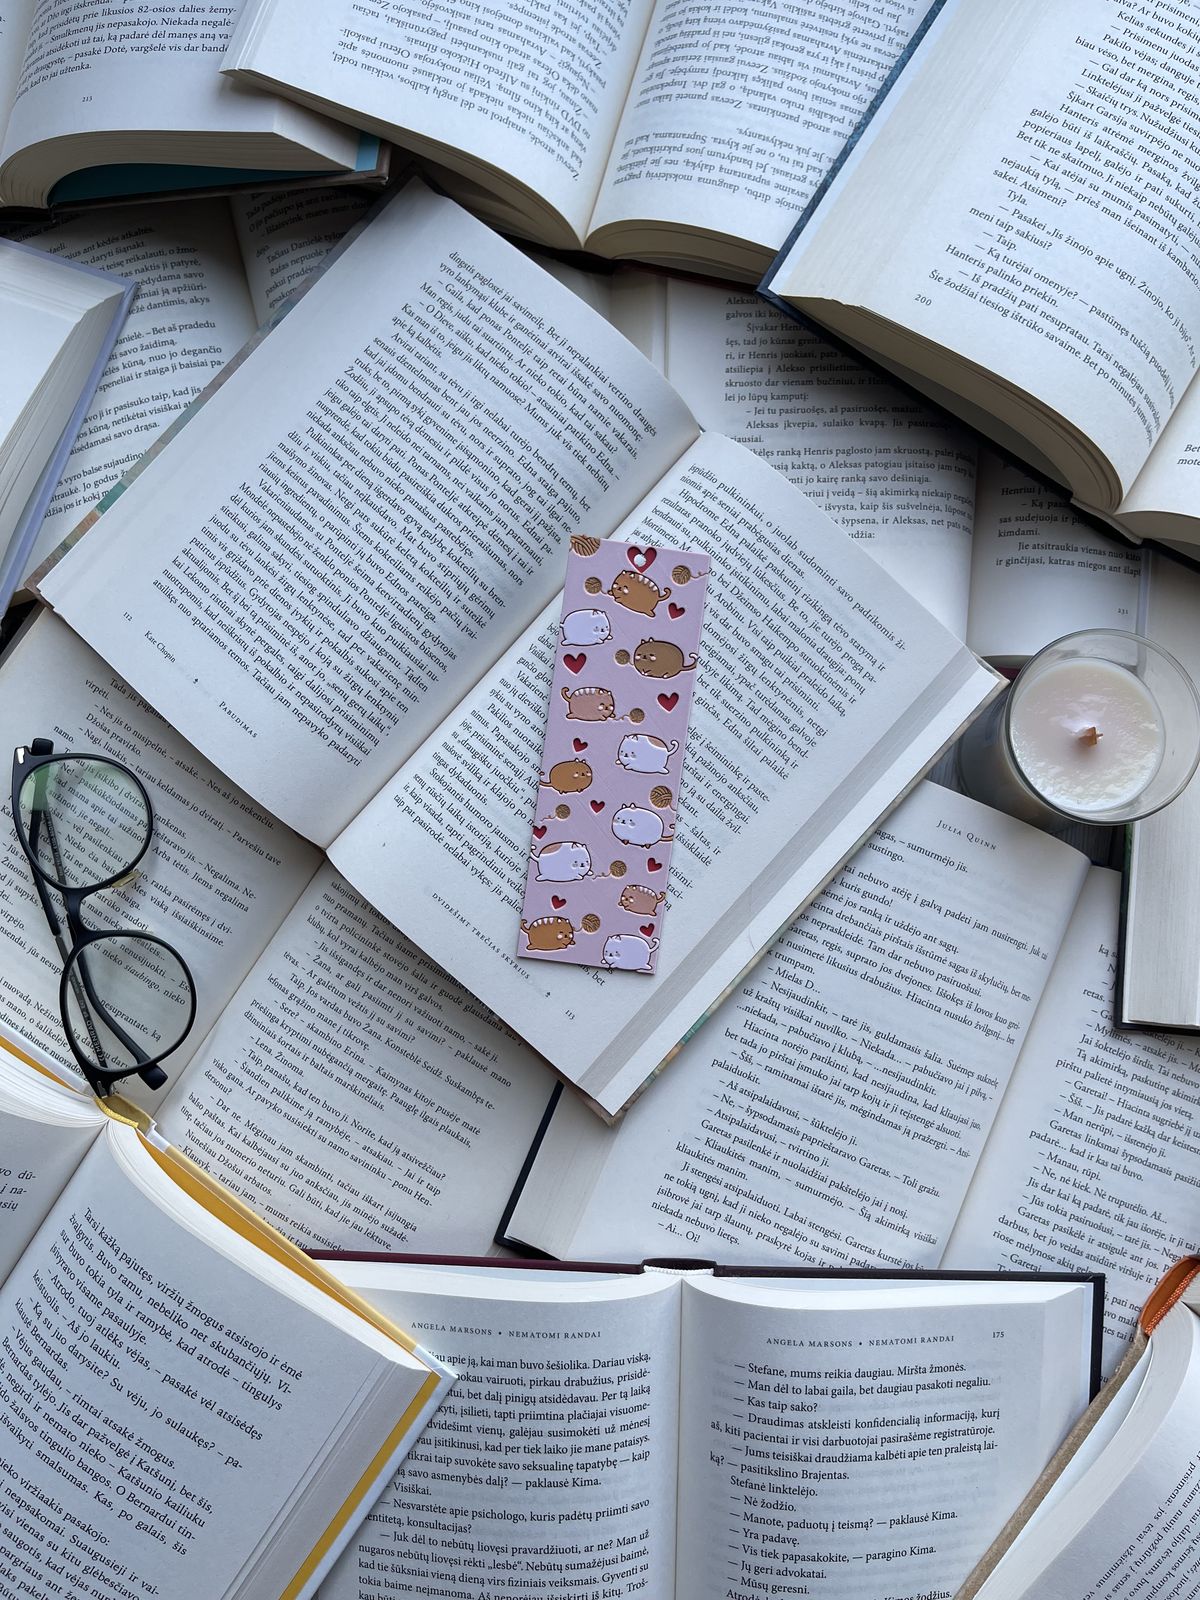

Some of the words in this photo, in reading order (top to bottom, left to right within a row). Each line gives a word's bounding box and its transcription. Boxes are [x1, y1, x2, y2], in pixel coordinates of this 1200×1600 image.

[82, 11, 99, 23] prie
[101, 7, 135, 17] likusios
[137, 5, 176, 14] 82-osios
[178, 4, 206, 14] dalies
[208, 5, 237, 16] žemy-
[73, 47, 102, 62] pasakė
[103, 45, 128, 54] Dotė,
[130, 43, 167, 55] vargšelė
[360, 63, 394, 80] veikiau
[992, 169, 1019, 186] sakei.
[1019, 180, 1068, 208] Atsimeni?
[1007, 189, 1028, 206] Tyla.
[969, 207, 996, 223] meni
[995, 218, 1015, 233] taip
[1014, 228, 1053, 251] sakiusi?
[996, 233, 1017, 251] Taip.
[945, 244, 986, 269] Hanteris
[984, 265, 1023, 287] palinko
[1021, 284, 1059, 308] priekin.
[986, 247, 1001, 262] Ką
[1001, 255, 1034, 276] turėjai
[1033, 272, 1079, 300] omenyje?
[914, 293, 933, 307] 200
[148, 353, 167, 363] nuo
[168, 350, 179, 361] jo
[180, 345, 223, 358] degančio
[448, 251, 476, 274] dingstis
[472, 272, 505, 296] paglostė
[500, 291, 515, 304] jai
[546, 326, 561, 342] Bet
[557, 337, 569, 347] ji
[566, 345, 610, 384] nepalankiai
[608, 382, 634, 409] vertino
[632, 408, 657, 438] draugės
[745, 419, 780, 430] Aleksas
[776, 447, 802, 459] ranką
[803, 447, 834, 456] Henris
[835, 446, 873, 458] paglosto
[874, 446, 892, 457] jam
[1004, 555, 1046, 568] ginčijasi,
[1048, 556, 1076, 567] katras
[1077, 560, 1107, 572] miegos
[678, 488, 720, 522] Hipodrome
[719, 518, 741, 540] Edna
[738, 537, 769, 563] palaikė
[764, 561, 804, 596] paskutinį
[801, 593, 833, 626] rizikingą
[832, 622, 850, 639] tėvo
[848, 637, 878, 668] statymą
[144, 630, 158, 645] Kate
[156, 642, 176, 663] Chopin
[699, 640, 737, 676] neigiamai,
[191, 615, 229, 651] aptariamos
[227, 648, 250, 673] temos.
[252, 667, 276, 695] Tačiau
[273, 691, 292, 709] jam
[291, 707, 329, 741] nepavyko
[327, 739, 363, 767] padaryti
[232, 831, 265, 857] Parvešiu
[906, 842, 955, 867] sumurmėjo
[954, 861, 968, 873] jis.
[431, 892, 471, 928] DVIDEŠIMT
[500, 953, 531, 980] SKYRIUS
[775, 966, 804, 986] Mielas
[804, 979, 821, 994] D...
[162, 989, 186, 1006] nieko
[711, 1058, 761, 1085] palaiduokit.
[375, 1066, 413, 1094] Kaimynas
[413, 1089, 436, 1108] kitoje
[434, 1105, 461, 1124] pusėje
[461, 1121, 481, 1136] matė
[701, 1119, 733, 1140] Garetas
[731, 1135, 772, 1158] pasilenkė
[798, 1132, 857, 1162] paprieštaravo
[858, 1156, 892, 1179] Garetas.
[902, 1174, 919, 1189] Toli
[917, 1184, 940, 1198] gražu.
[1046, 1151, 1080, 1173] Manau,
[1081, 1168, 1101, 1181] rūpi.
[294, 1154, 334, 1183] skambinti,
[336, 1179, 361, 1197] tačiau
[361, 1193, 385, 1212] iškart
[383, 1209, 418, 1233] įsijungia
[665, 1222, 683, 1237] Ai...
[685, 1230, 701, 1244] Oi!
[84, 1207, 101, 1232] Tarsi
[97, 1226, 121, 1257] kažką
[118, 1252, 154, 1286] pajutęs,
[157, 1280, 185, 1308] viržių
[184, 1300, 225, 1332] žmogus
[224, 1329, 269, 1360] atsistojo
[268, 1354, 281, 1366] ir
[279, 1361, 303, 1381] ėmė
[100, 1306, 147, 1346] pasaulyje.
[411, 1322, 447, 1332] ANGELA
[449, 1325, 492, 1336] MARSONS
[508, 1330, 561, 1340] NEMATOMI
[563, 1331, 601, 1340] RANDAI
[766, 1337, 805, 1348] ANGELA
[808, 1340, 853, 1348] MARSONS
[868, 1337, 917, 1347] NEMATOMI
[920, 1335, 955, 1344] RANDAI
[992, 1331, 1005, 1339] 175
[447, 1354, 467, 1367] apie
[466, 1355, 479, 1369] ją,
[479, 1355, 495, 1368] kai
[496, 1360, 518, 1369] man
[519, 1358, 545, 1371] buvo
[545, 1359, 591, 1371] šešiolika.
[592, 1357, 626, 1369] Dariau
[626, 1352, 652, 1365] viską,
[748, 1362, 788, 1379] Stefane,
[789, 1370, 822, 1380] mums
[824, 1368, 853, 1380] reikia
[854, 1367, 895, 1381] daugiau.
[897, 1365, 928, 1377] Miršta
[929, 1362, 967, 1374] žmonės.
[161, 1373, 199, 1400] pasakė
[200, 1396, 217, 1412] vėl
[216, 1408, 263, 1441] atsisėdęs
[747, 1395, 766, 1409] Kas
[768, 1400, 788, 1414] taip
[789, 1401, 818, 1413] sako?
[525, 1477, 570, 1491] paklausė
[571, 1477, 602, 1488] Kima.
[1164, 1461, 1197, 1507] prisimena:
[743, 1494, 759, 1507] Nė
[760, 1498, 797, 1513] žodžio.
[1153, 1506, 1165, 1521] jos
[1135, 1522, 1155, 1543] tėvai
[1095, 1544, 1136, 1589] užsiėmimus
